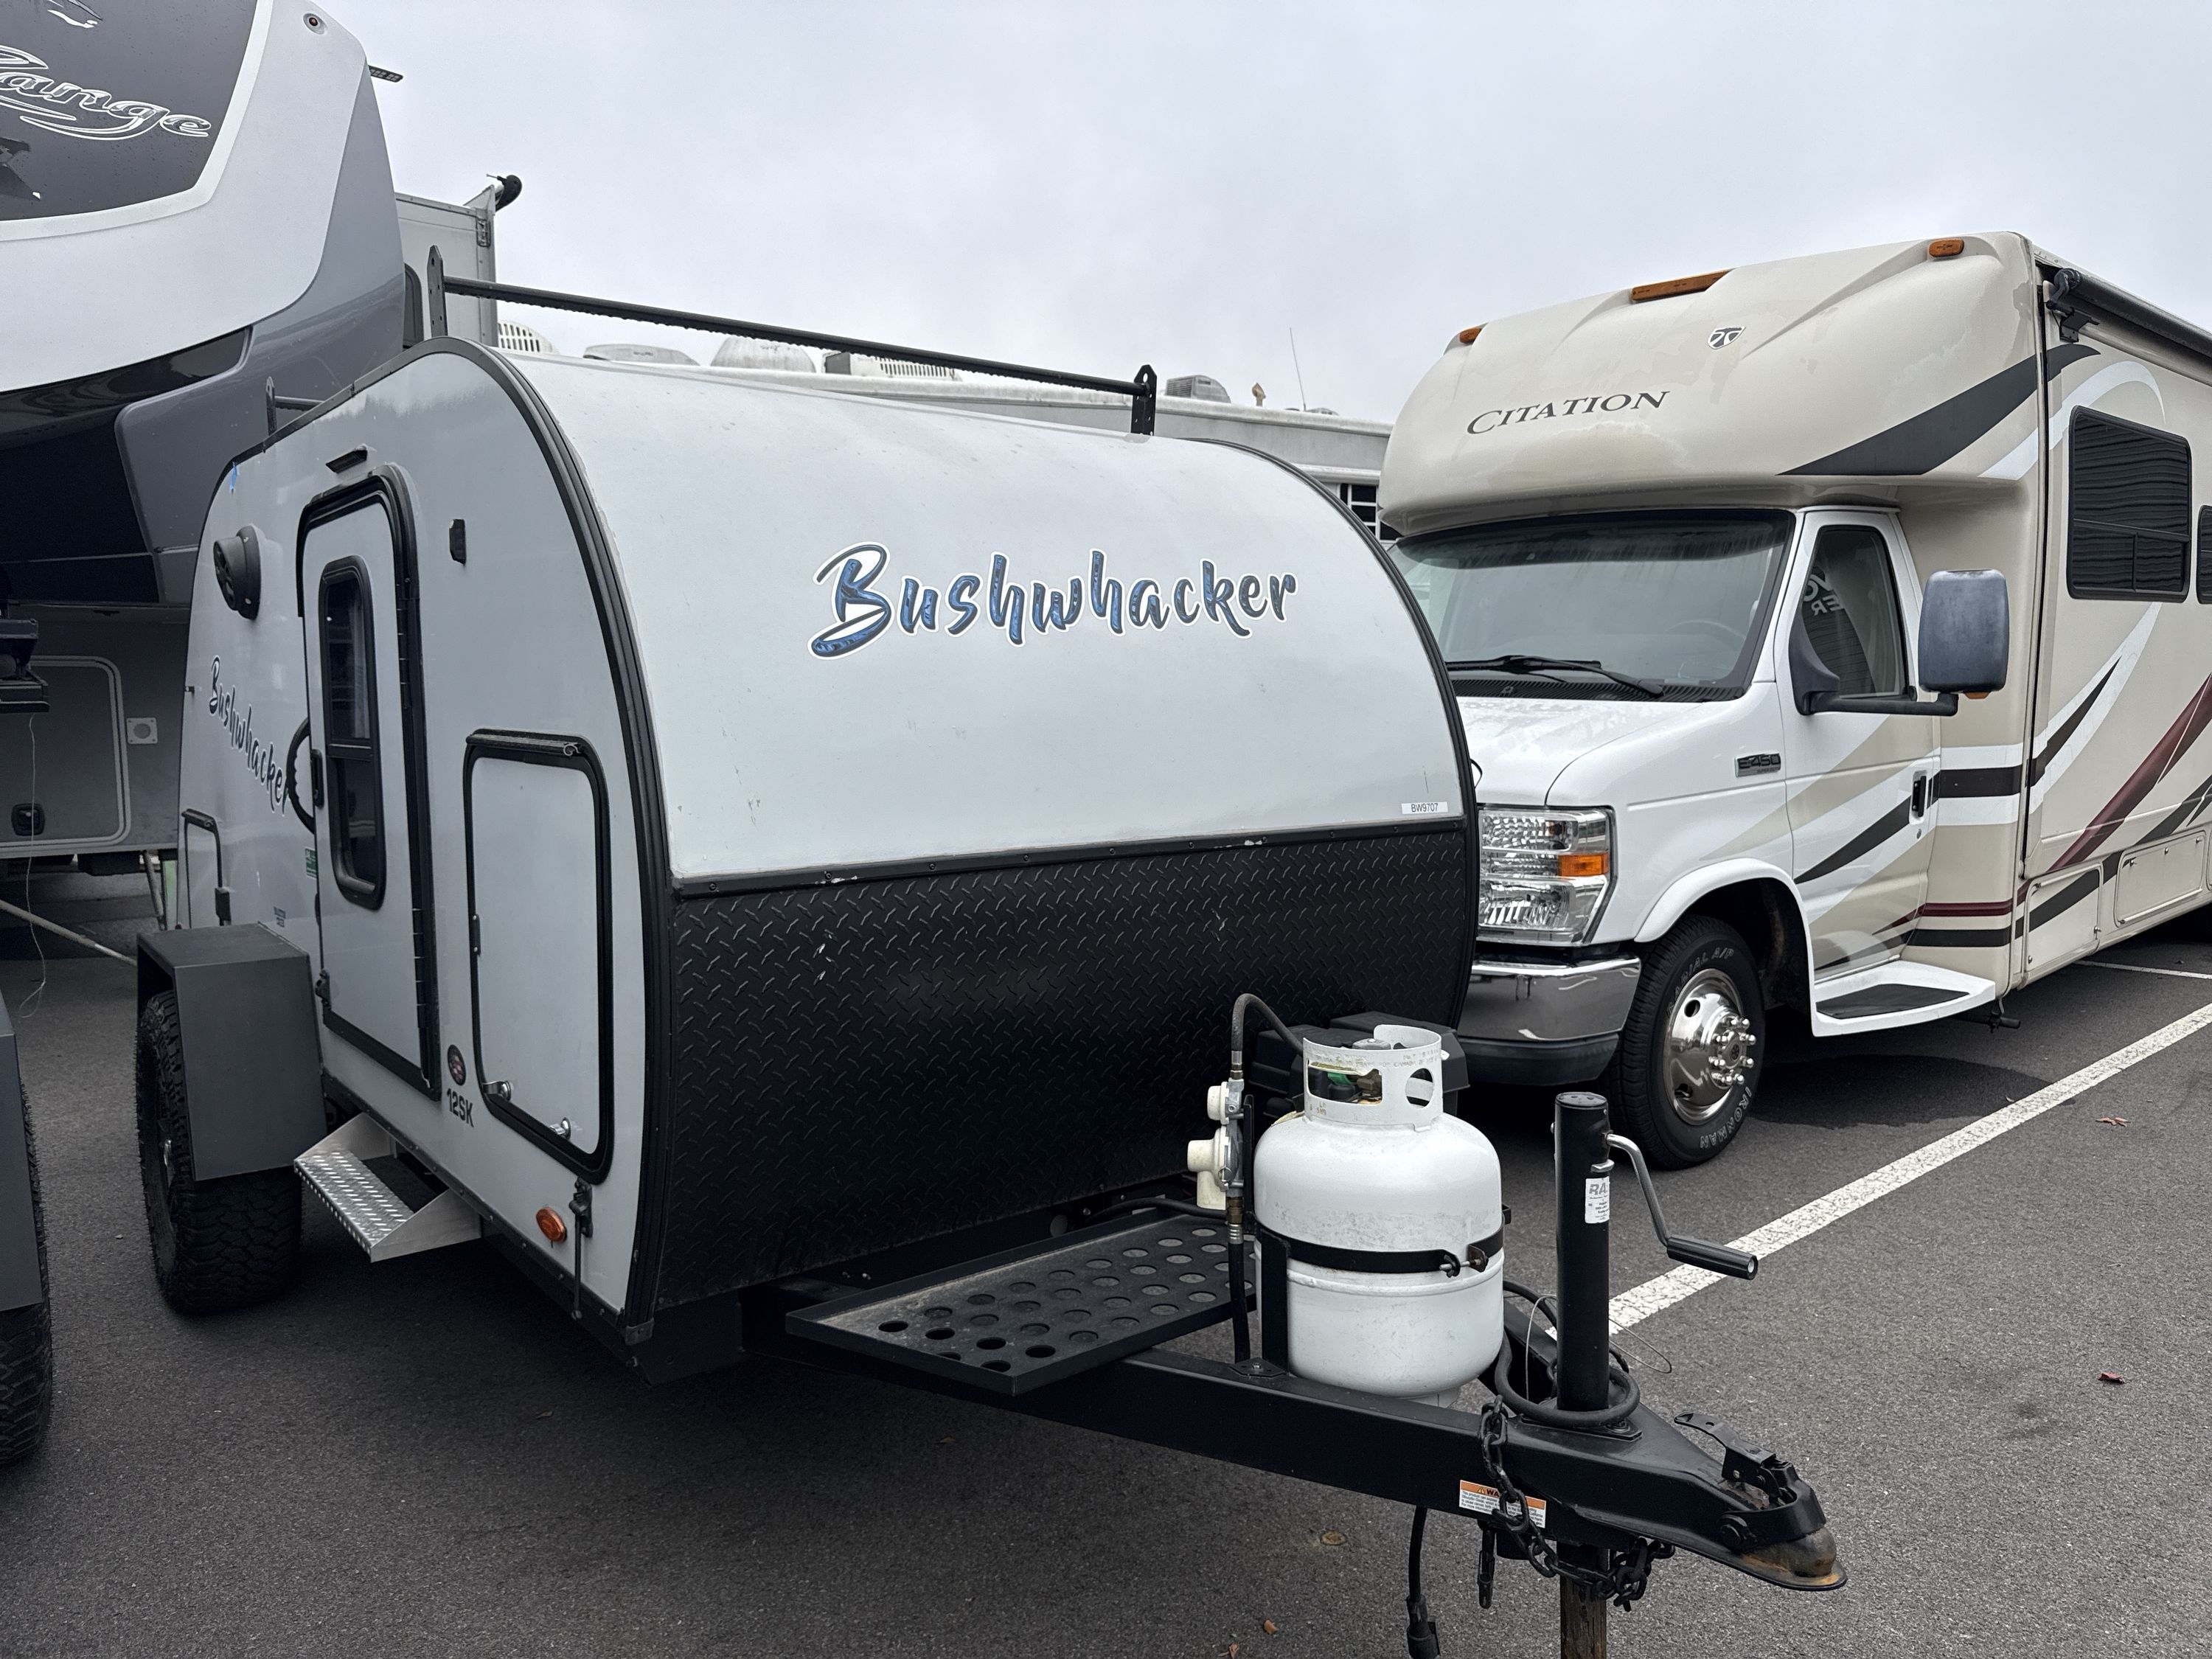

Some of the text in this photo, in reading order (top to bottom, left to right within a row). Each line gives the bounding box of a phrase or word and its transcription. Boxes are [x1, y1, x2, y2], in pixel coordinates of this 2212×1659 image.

[1467, 391, 1670, 434] CITATION
[809, 543, 1297, 658] Bushwhacker
[1737, 753, 1781, 769] E-450
[1411, 803, 1439, 813] BW9707
[447, 1088, 474, 1128] 12SK
[1700, 1086, 1752, 1149] IRONMAN
